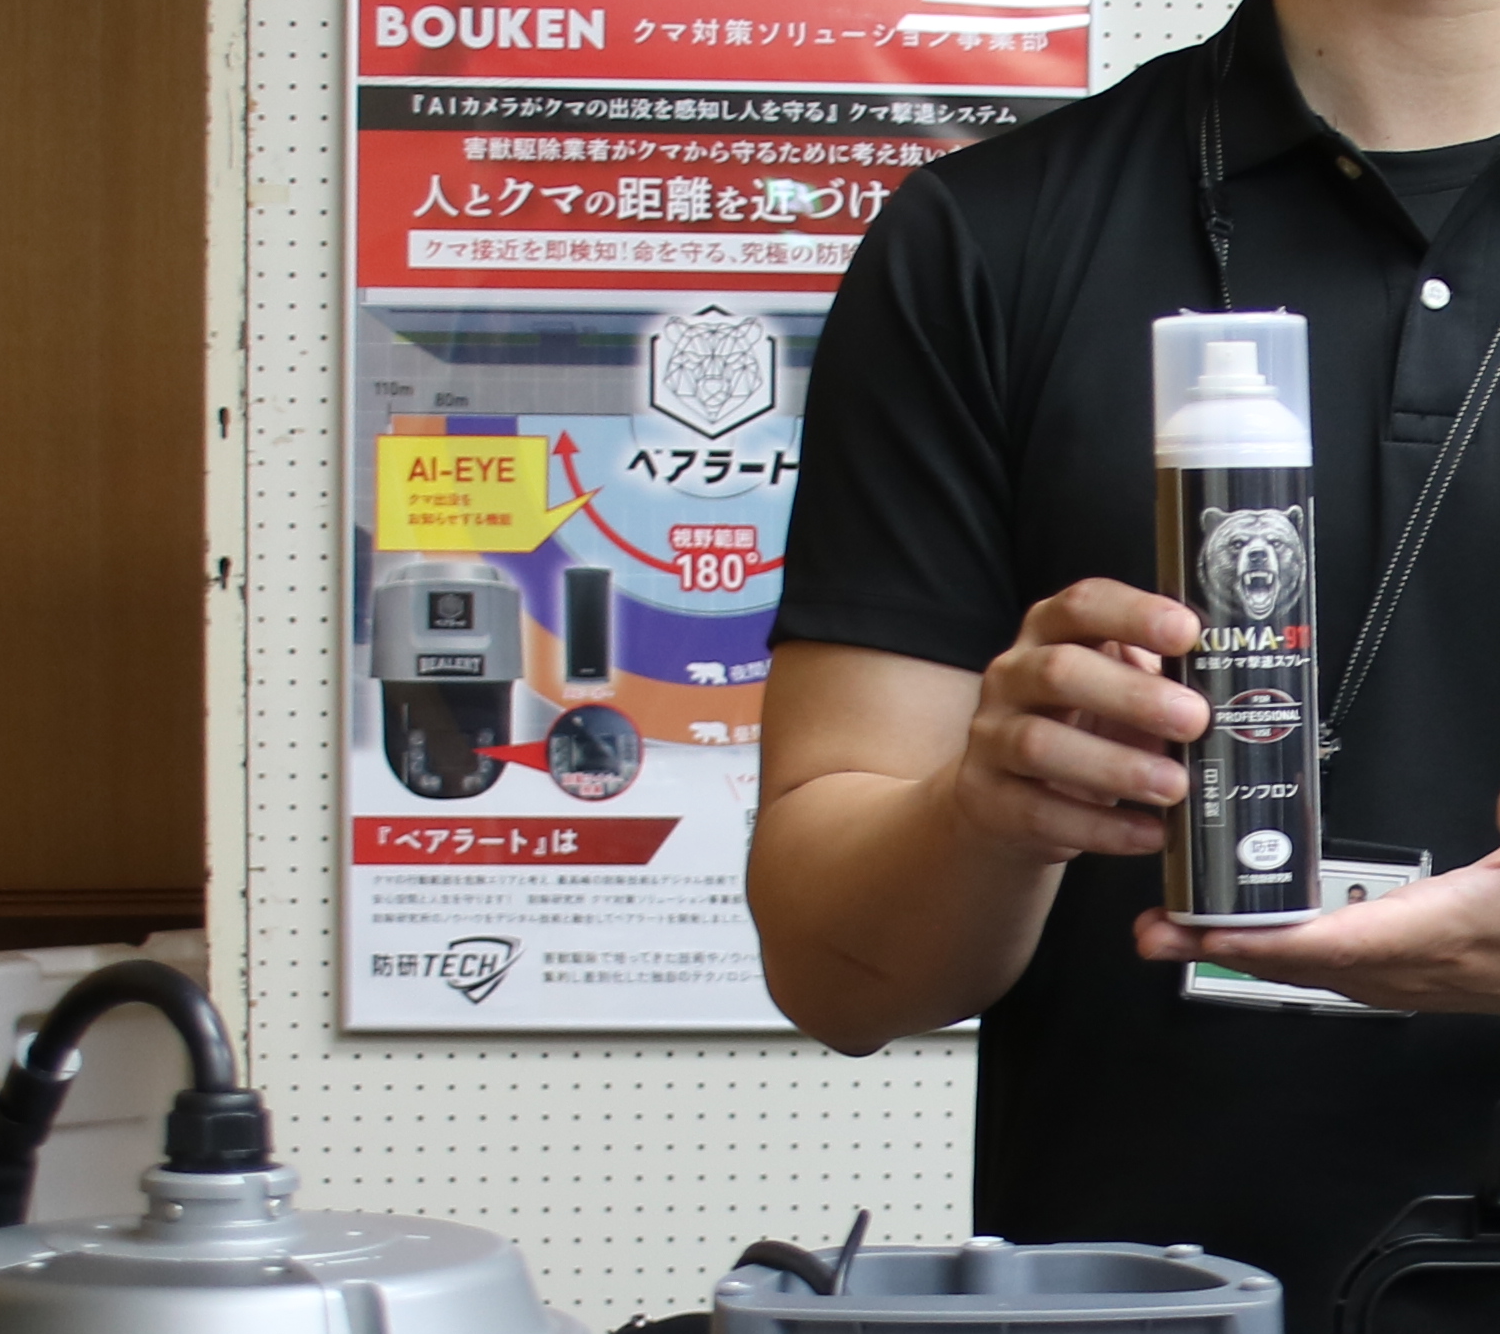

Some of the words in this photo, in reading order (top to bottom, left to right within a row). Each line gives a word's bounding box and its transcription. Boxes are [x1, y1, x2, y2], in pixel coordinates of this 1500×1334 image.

[374, 5, 607, 50] BOUKEN
[462, 136, 965, 167] 害獣駆除業者がクマから守るために考え抜い
[408, 456, 516, 483] AI-EYE
[626, 449, 800, 485] ベアラート
[671, 527, 755, 548] 視野範囲
[675, 550, 760, 590] 180°
[1215, 708, 1301, 724] PROFESSIONAL
[1202, 768, 1220, 818] 日本製
[1225, 782, 1299, 801] ノンフロン
[377, 825, 579, 857] 『ベアラート』は
